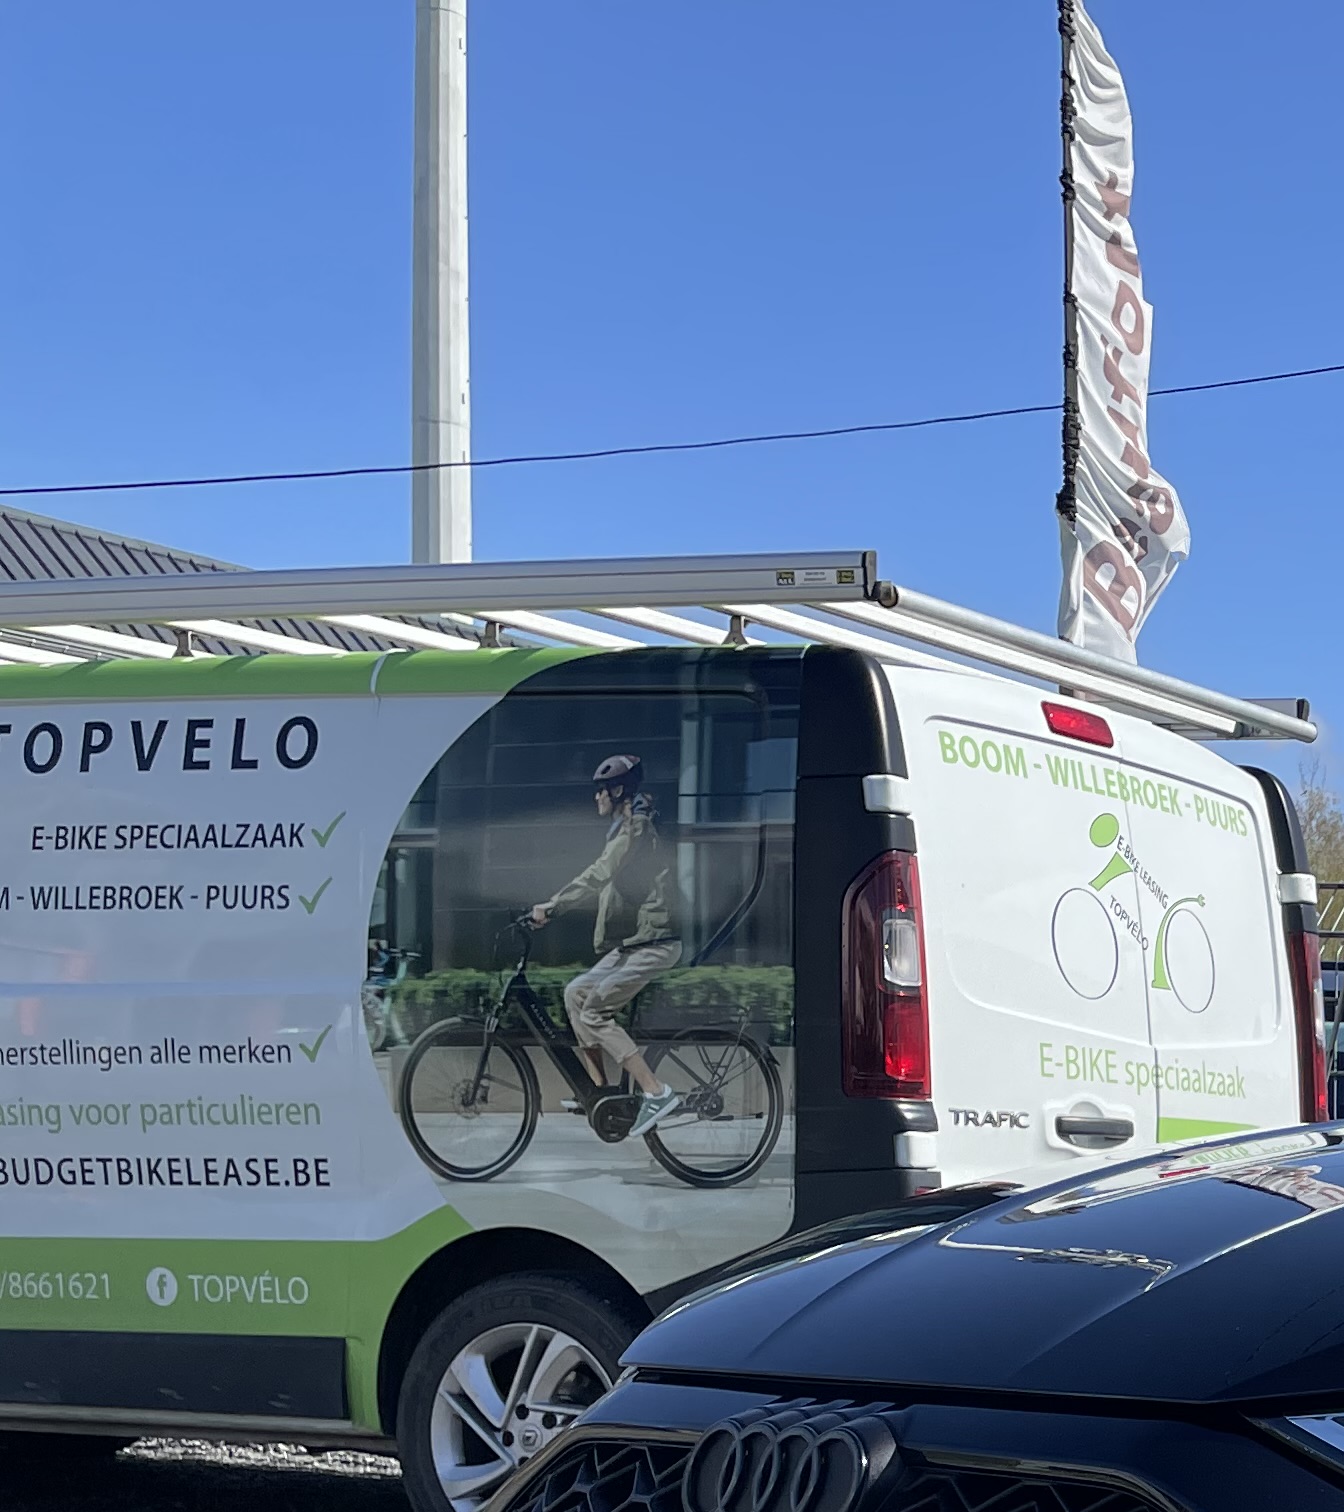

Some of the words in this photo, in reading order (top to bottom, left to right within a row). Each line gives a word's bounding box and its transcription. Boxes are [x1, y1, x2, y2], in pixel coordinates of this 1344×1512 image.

[938, 730, 1029, 779] BOOM
[1045, 753, 1184, 817] WILLEBROEK
[1193, 793, 1248, 837] PUURS
[31, 824, 108, 850] E-BIKE
[114, 822, 306, 850] SPECIAALZAAK
[1116, 834, 1140, 874] E-BIKE
[1139, 866, 1169, 910] LEASING
[30, 885, 185, 911] WILLEBROEK
[205, 884, 291, 910] PUURS
[1109, 894, 1149, 951] TOPVÉLO
[150, 1037, 192, 1064] alle
[199, 1036, 292, 1064] merken
[1039, 1042, 1119, 1084] E-BIKE
[1124, 1058, 1246, 1099] speciaalzaak
[69, 1102, 132, 1126] voor
[139, 1093, 322, 1134] particulieren
[948, 1107, 1031, 1129] TRAFIC
[187, 1270, 310, 1305] TOPVÉLO
